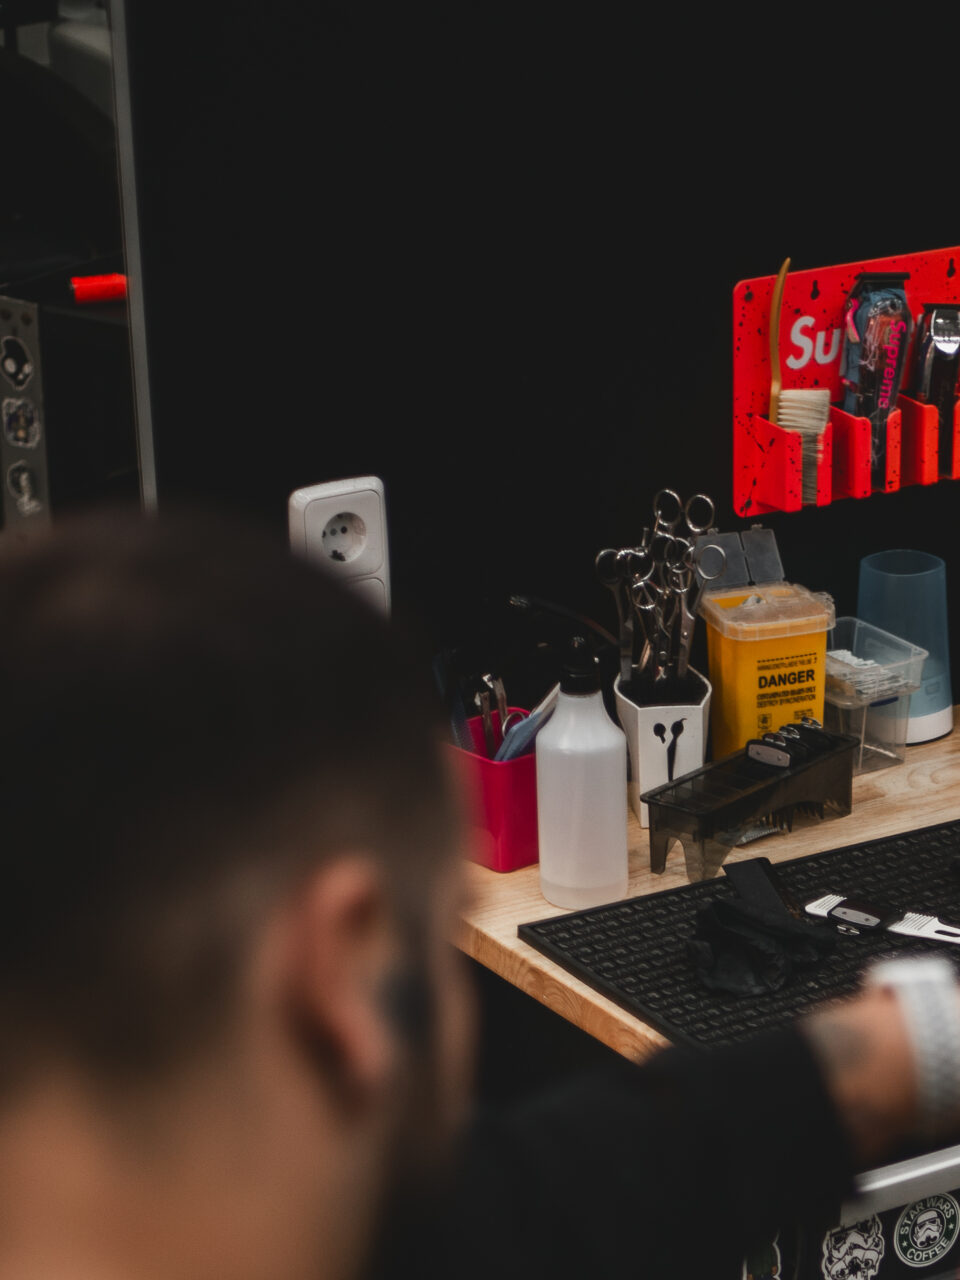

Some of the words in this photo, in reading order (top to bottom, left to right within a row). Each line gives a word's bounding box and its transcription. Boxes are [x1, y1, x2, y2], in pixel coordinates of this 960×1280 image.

[878, 320, 906, 409] Supreme
[758, 669, 815, 689] DANGER
[900, 1201, 925, 1235] STAR
[926, 1195, 954, 1219] WARS
[906, 1236, 950, 1262] COFFEE
